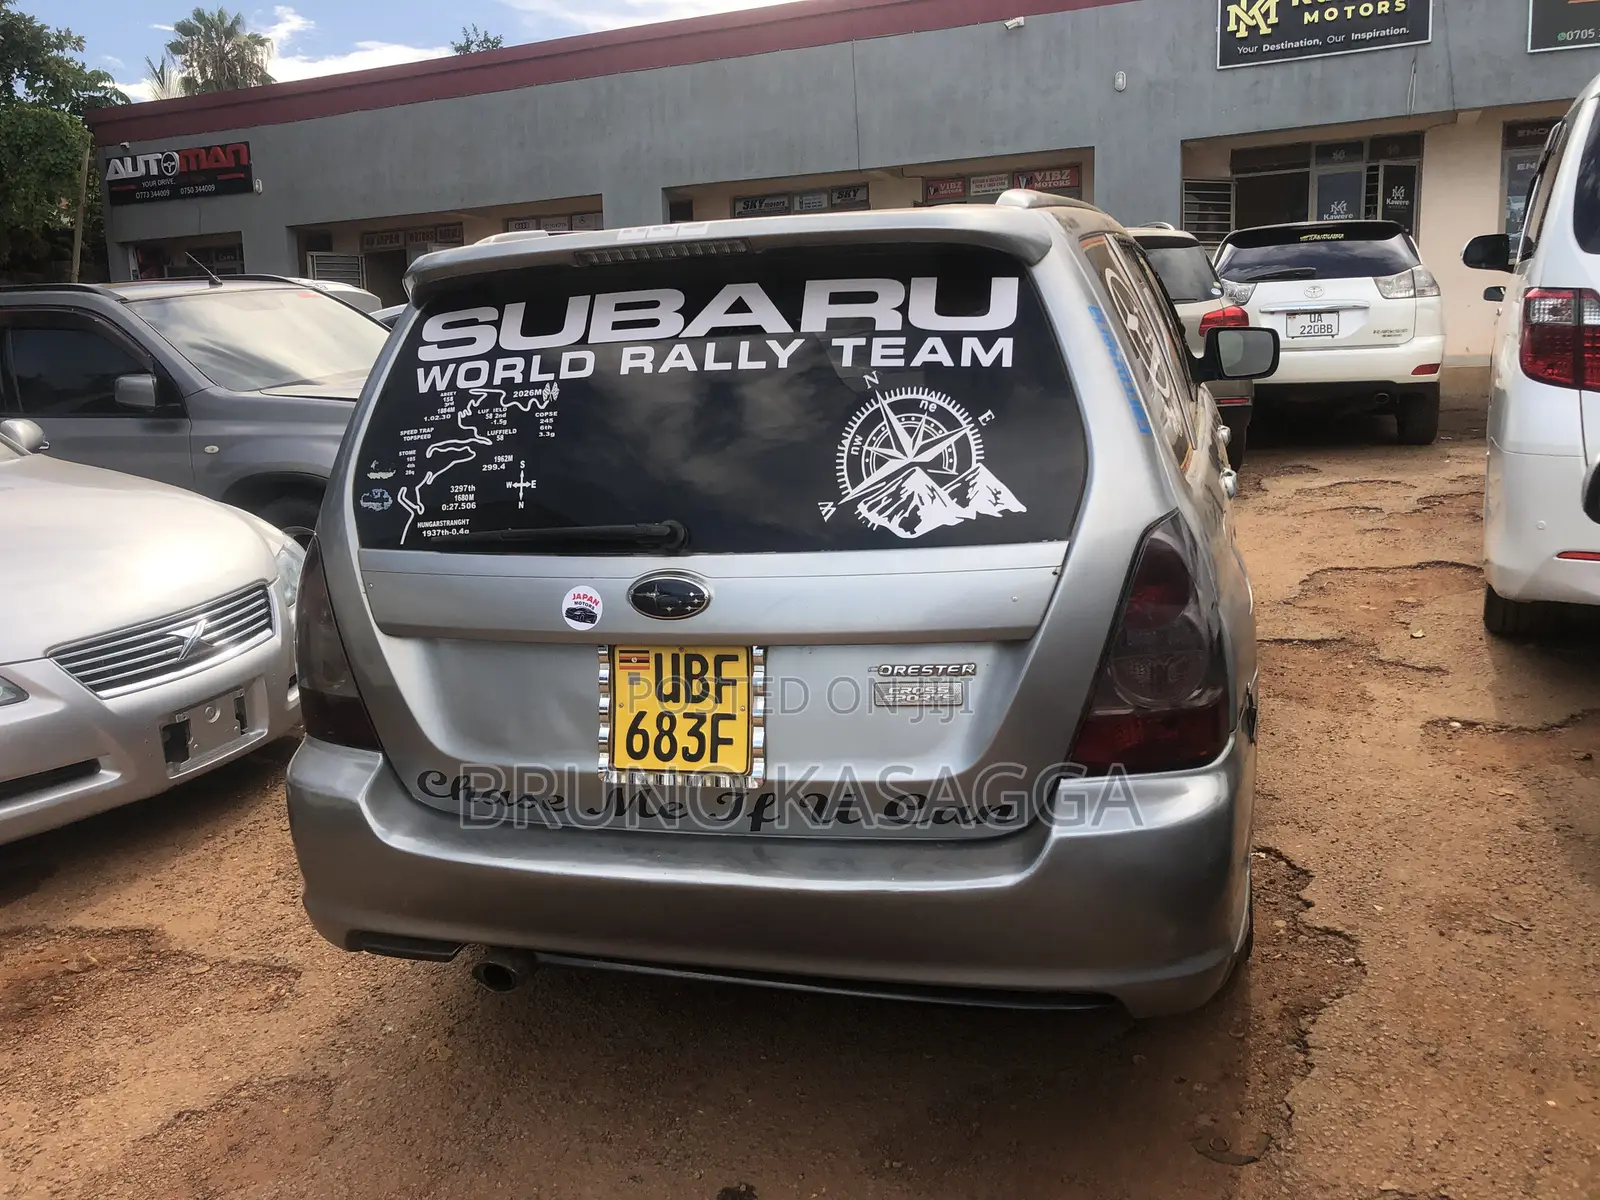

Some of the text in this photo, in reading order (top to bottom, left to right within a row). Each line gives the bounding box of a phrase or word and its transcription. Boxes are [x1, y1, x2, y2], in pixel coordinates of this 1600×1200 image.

[1303, 0, 1407, 24] MOTORS
[1566, 28, 1595, 41] 0705
[1237, 26, 1410, 55] Your Destination, Our Inspiration.
[1034, 169, 1071, 181] VIBZ
[141, 180, 157, 188] YOUR
[939, 181, 963, 191] VIBZ
[1034, 180, 1071, 189] MOTORS
[135, 184, 216, 200] 0773 344009 0750 344009
[836, 188, 860, 200] SKY
[742, 197, 766, 210] SKY
[1386, 198, 1410, 206] Kawere
[1323, 213, 1354, 221] Kawere
[417, 277, 1018, 362] SUBARU
[1309, 313, 1323, 324] UA
[416, 337, 1014, 393] WORLD RALLY TEAM
[862, 370, 880, 389] N
[513, 389, 542, 398] 2026M
[919, 400, 937, 413] ne
[424, 414, 451, 422] 1.02.30
[977, 409, 996, 426] E
[487, 428, 518, 436] LUFFIELD
[403, 434, 432, 442] TOPSPEED
[482, 463, 506, 472] 299.4
[519, 460, 526, 469] S
[450, 484, 476, 493] 3297th
[506, 480, 537, 489] W E
[454, 494, 475, 502] 1680M
[441, 502, 477, 511] 0:27.506
[518, 501, 525, 510] N
[572, 593, 600, 606] JAPAN
[574, 600, 595, 611] MOTORS
[654, 653, 739, 705] UBF
[625, 710, 737, 763] 683F
